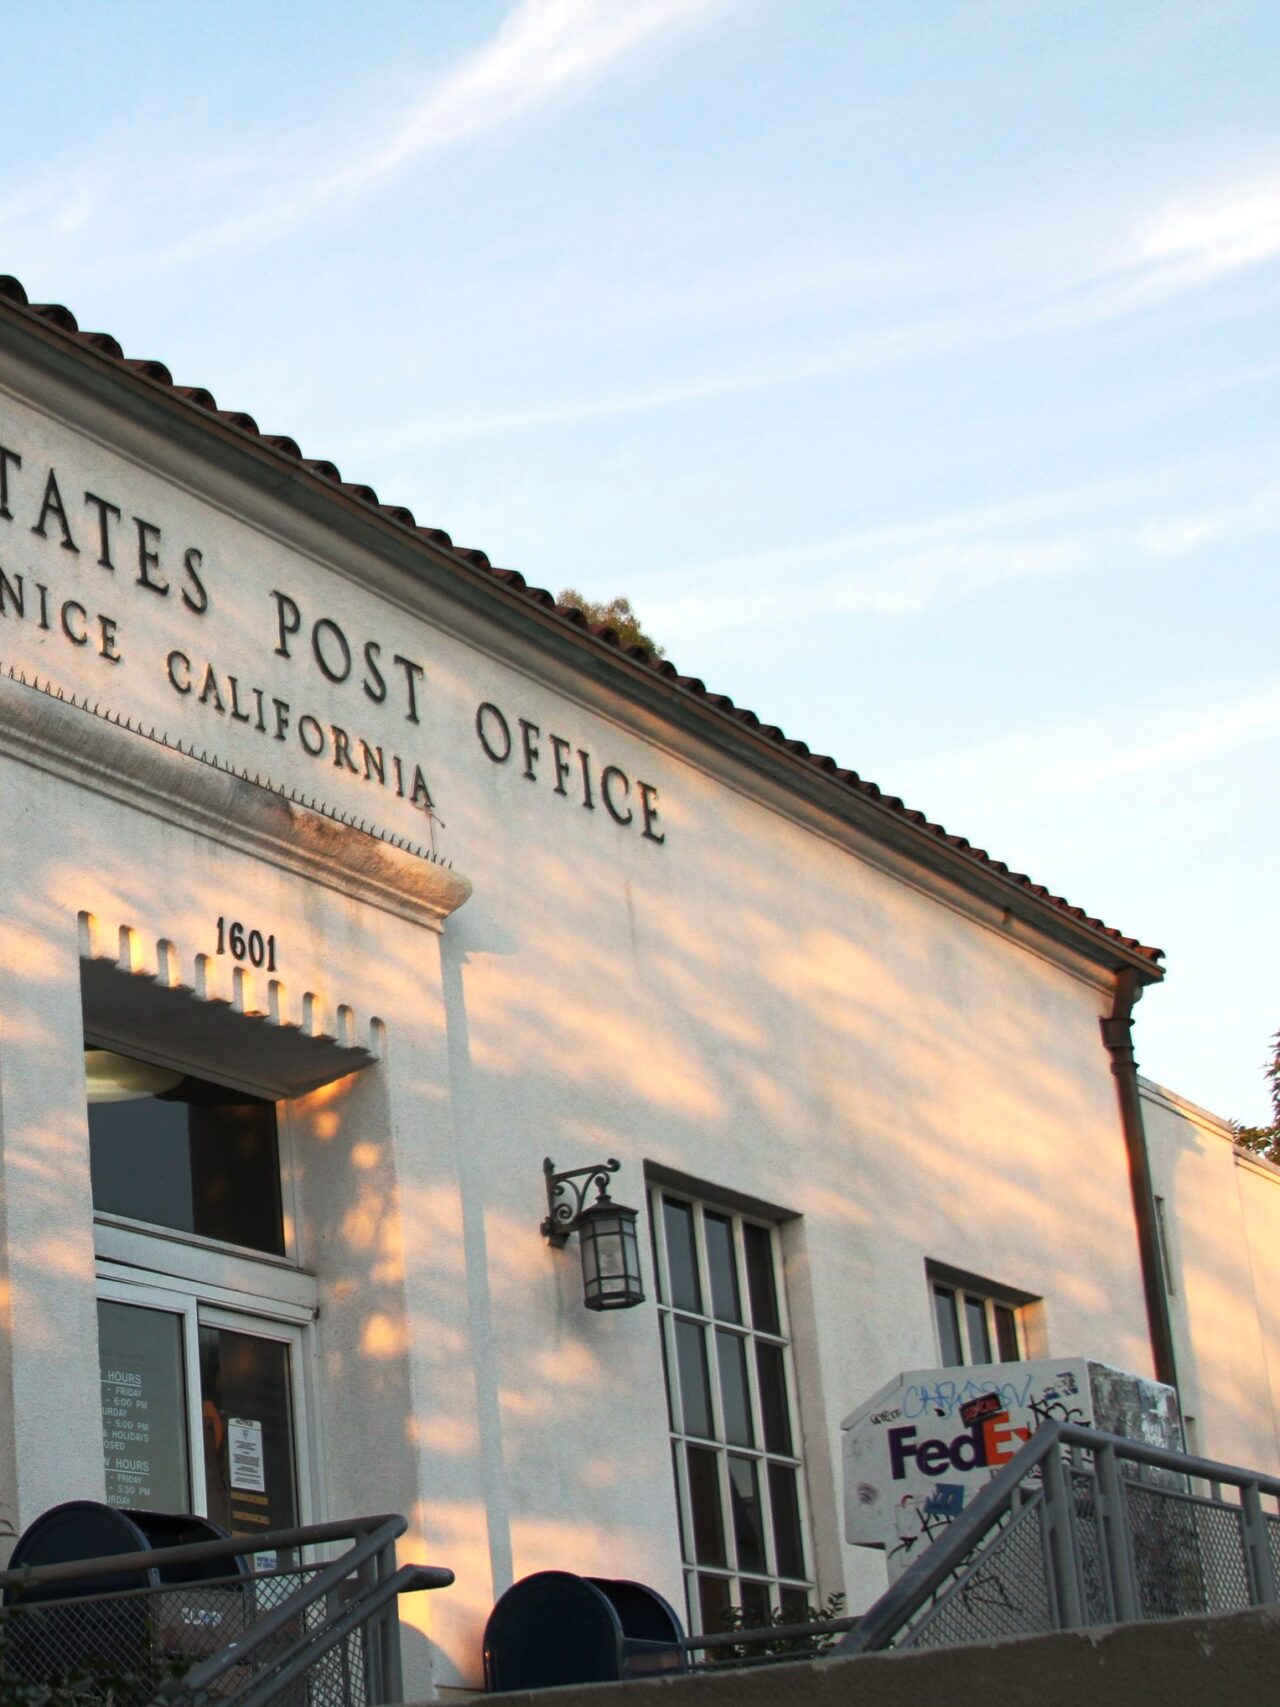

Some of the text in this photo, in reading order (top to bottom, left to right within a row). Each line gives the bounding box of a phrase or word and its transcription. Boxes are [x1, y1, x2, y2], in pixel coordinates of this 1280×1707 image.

[270, 589, 425, 725] POST
[475, 702, 666, 845] OFFICE
[166, 650, 436, 808] CALIFORNIA
[216, 916, 276, 973] 1601
[107, 1370, 142, 1385] HOURS
[115, 1386, 142, 1397] FRIDAY
[136, 1400, 148, 1409] PM
[137, 1422, 149, 1431] PM
[111, 1430, 150, 1442] HOLIDAYS
[888, 1411, 1031, 1480] FedE
[115, 1458, 150, 1472] HOURS
[117, 1473, 142, 1484] FRIDAY
[138, 1486, 151, 1496] PM
